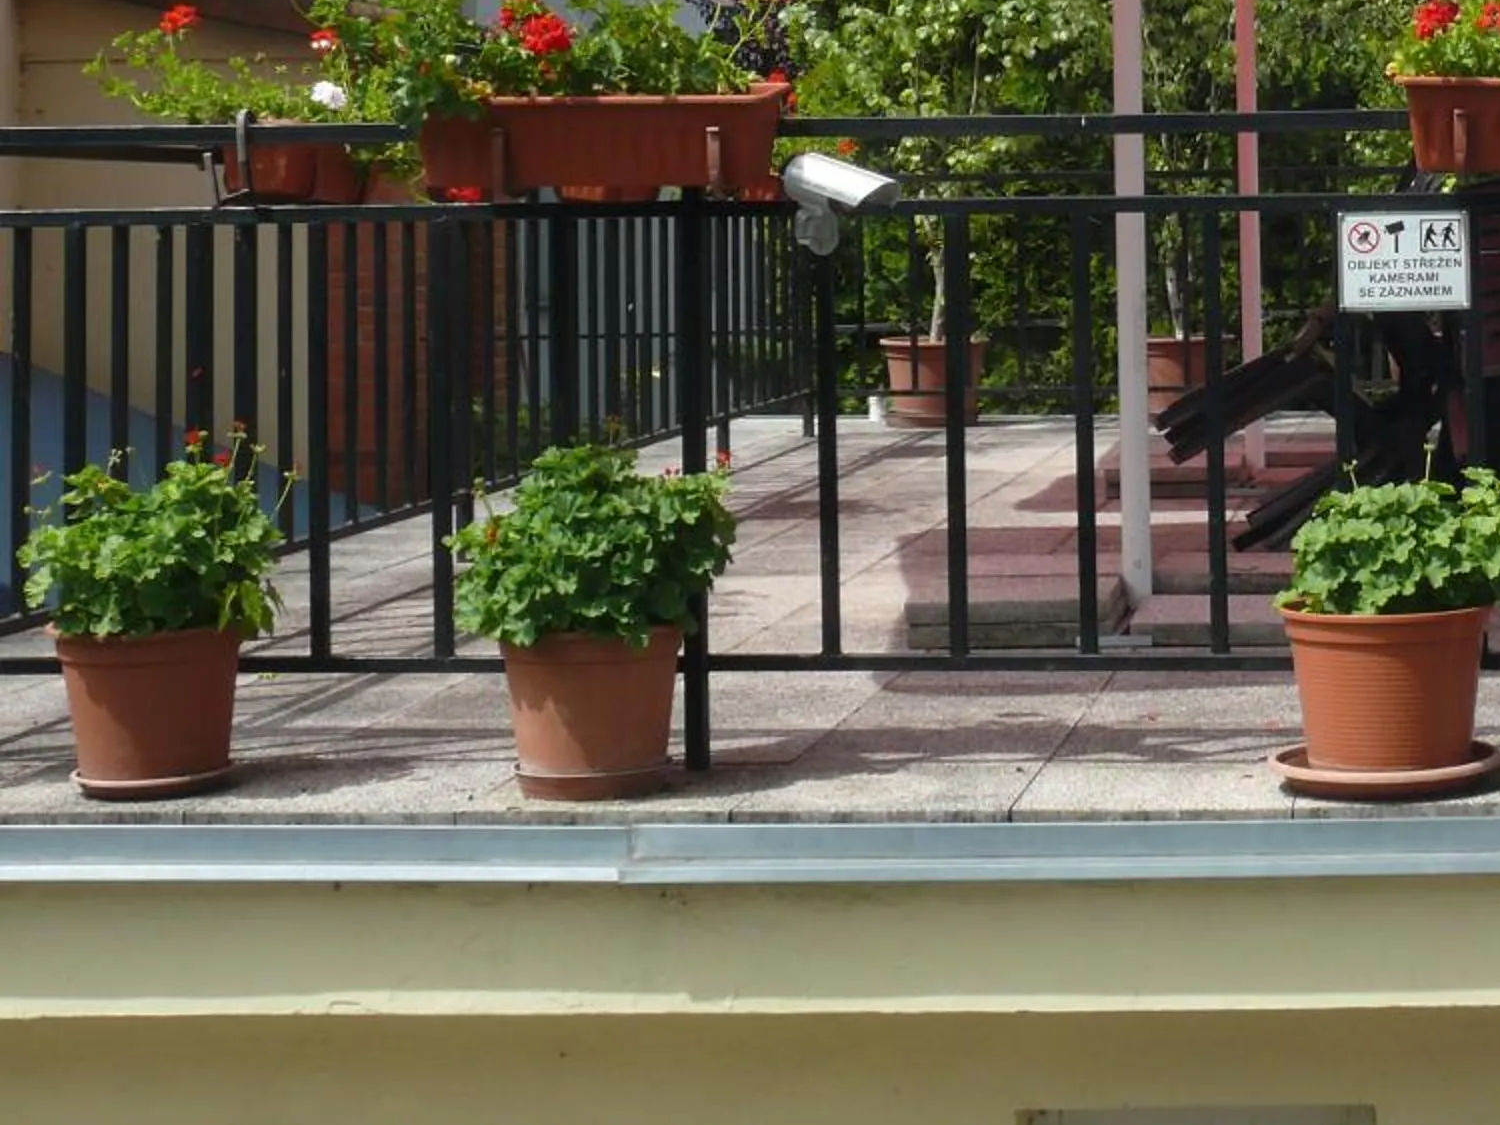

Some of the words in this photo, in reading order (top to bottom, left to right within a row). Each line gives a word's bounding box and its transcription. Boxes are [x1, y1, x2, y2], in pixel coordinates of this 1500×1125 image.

[1347, 258, 1398, 270] OBJEKT
[1369, 273, 1439, 284] KAMERAMI
[1359, 287, 1375, 298] SE
